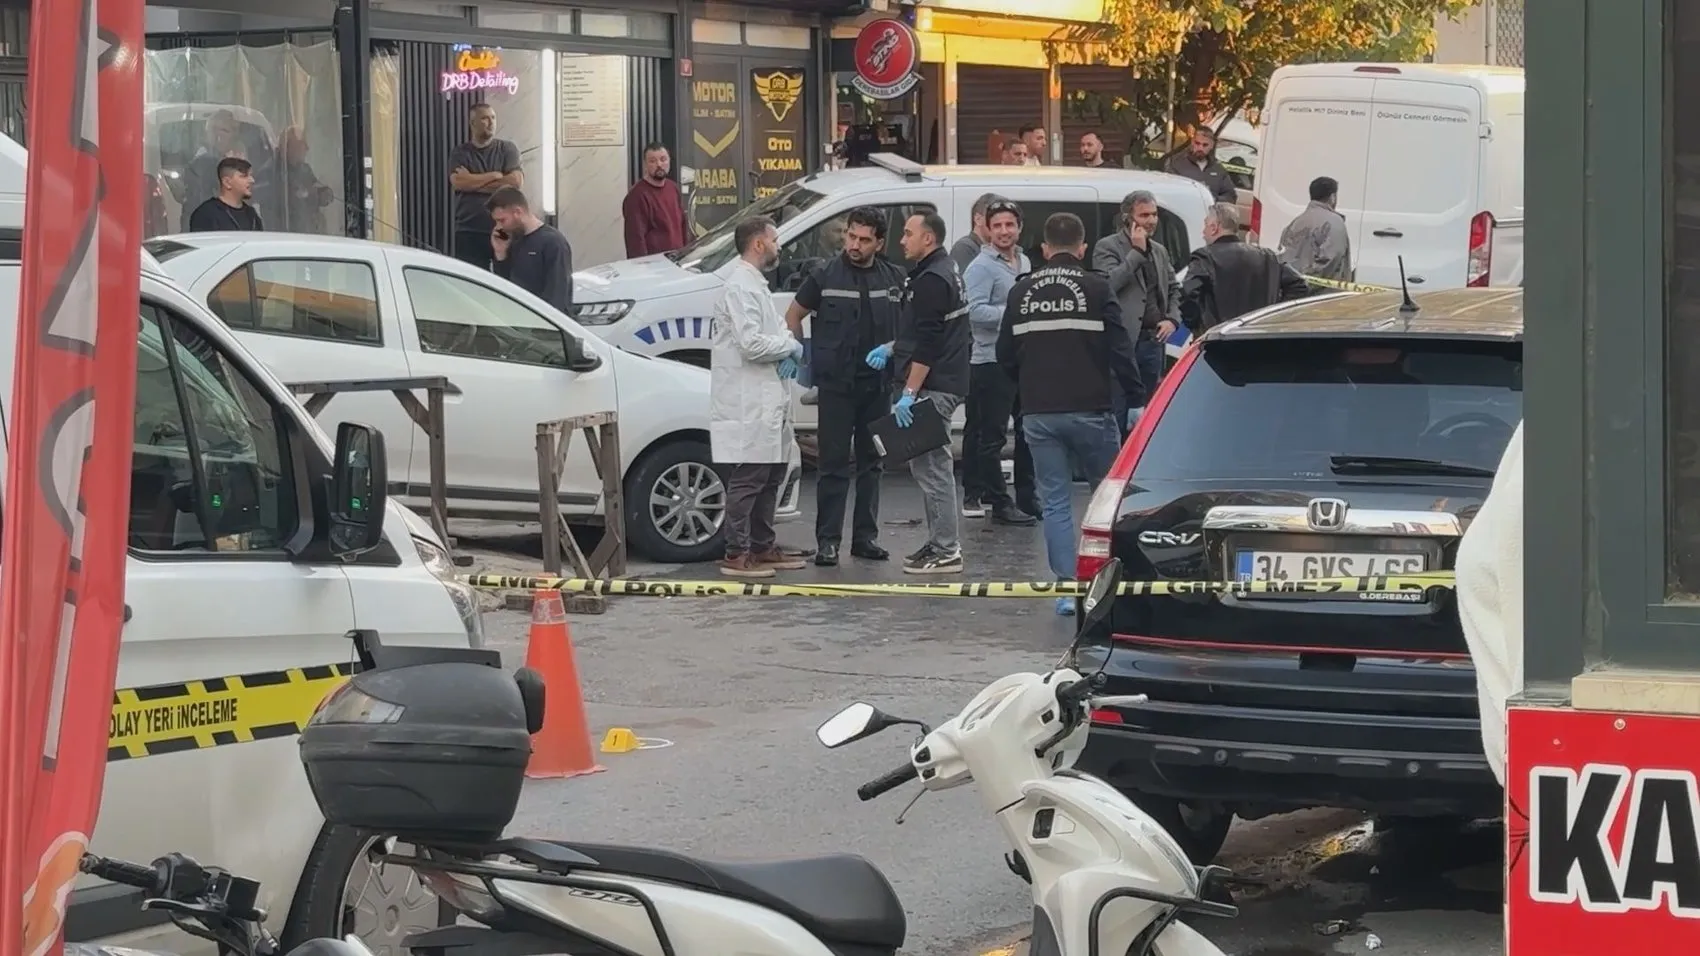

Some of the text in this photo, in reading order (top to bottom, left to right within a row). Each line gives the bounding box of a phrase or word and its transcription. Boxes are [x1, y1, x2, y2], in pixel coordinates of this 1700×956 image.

[693, 81, 735, 102] MOTOR
[768, 137, 792, 151] OTO
[758, 158, 803, 171] YIKAMA
[695, 168, 737, 188] ARABA
[1020, 290, 1033, 314] OLAY
[1030, 298, 1074, 313] POLİS
[1138, 531, 1200, 546] CR-V
[1256, 555, 1289, 581] 34
[109, 709, 142, 738] OLAY
[1531, 764, 1700, 917] KA
